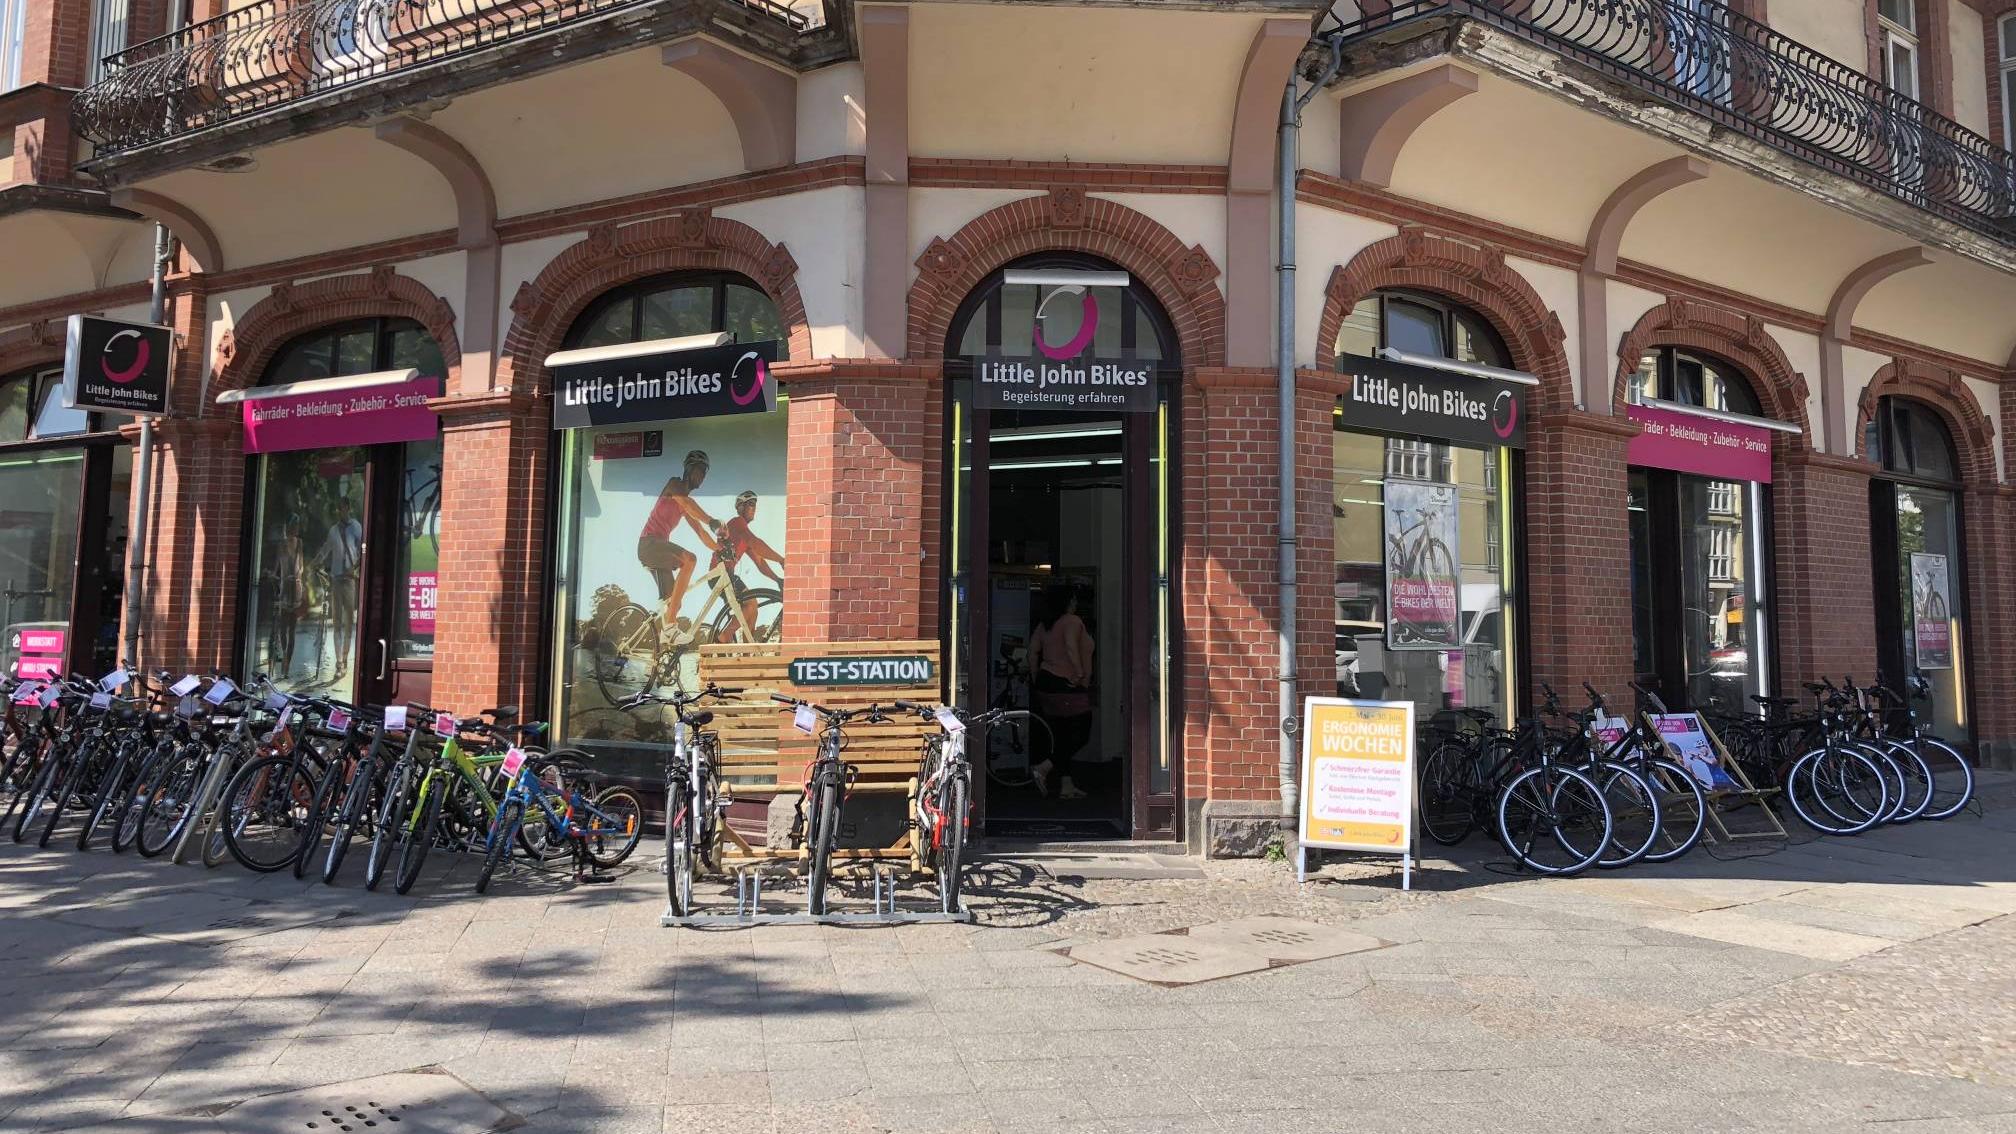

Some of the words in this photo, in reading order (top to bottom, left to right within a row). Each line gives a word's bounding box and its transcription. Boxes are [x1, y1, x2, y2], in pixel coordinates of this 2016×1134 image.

[981, 362, 1035, 384] Little
[1039, 363, 1086, 389] John
[85, 383, 110, 396] Little
[111, 387, 132, 398] John
[133, 389, 158, 401] Bikes
[565, 375, 614, 406] Little
[616, 372, 661, 409] John
[665, 367, 722, 397] Bikes
[1002, 390, 1075, 405] Begeisterung
[1078, 391, 1125, 403] erfahren
[1353, 374, 1399, 407] Little
[1401, 382, 1440, 415] John
[1443, 389, 1487, 420] Bikes
[251, 405, 290, 421] Fahrräder
[296, 402, 343, 417] Bekleidung
[350, 395, 387, 412] Zubehör
[394, 391, 427, 407] Service
[1669, 423, 1708, 446] Bekleidung
[1713, 431, 1740, 448] Zubehör
[1745, 436, 1768, 453] Service
[1394, 584, 1406, 595] DIE
[1394, 597, 1420, 608] E-BIKES
[793, 660, 929, 680] TEST-STATION
[1322, 719, 1402, 737] ERGONOMIE
[1322, 734, 1402, 755] WOCHEN
